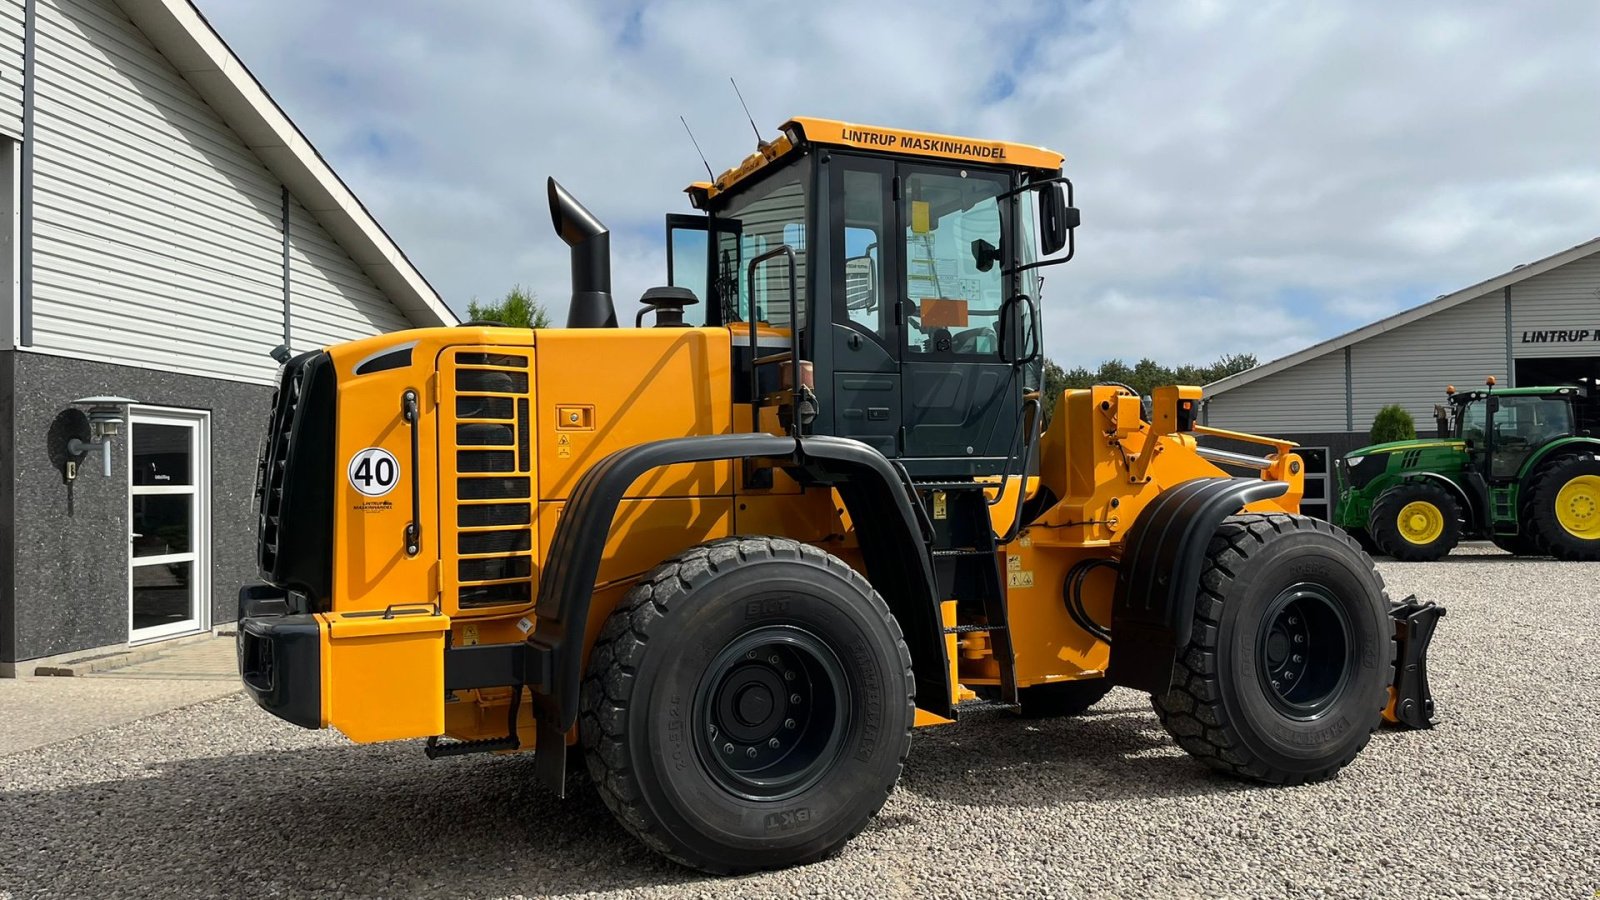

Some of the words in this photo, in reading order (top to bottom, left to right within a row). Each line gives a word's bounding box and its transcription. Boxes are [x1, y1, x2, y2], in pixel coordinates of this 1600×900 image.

[841, 128, 897, 146] LINTRUP
[900, 136, 1007, 159] MASKINHANDEL
[1522, 330, 1589, 343] LINTRUP
[354, 457, 394, 487] 40
[766, 808, 811, 830] BKT
